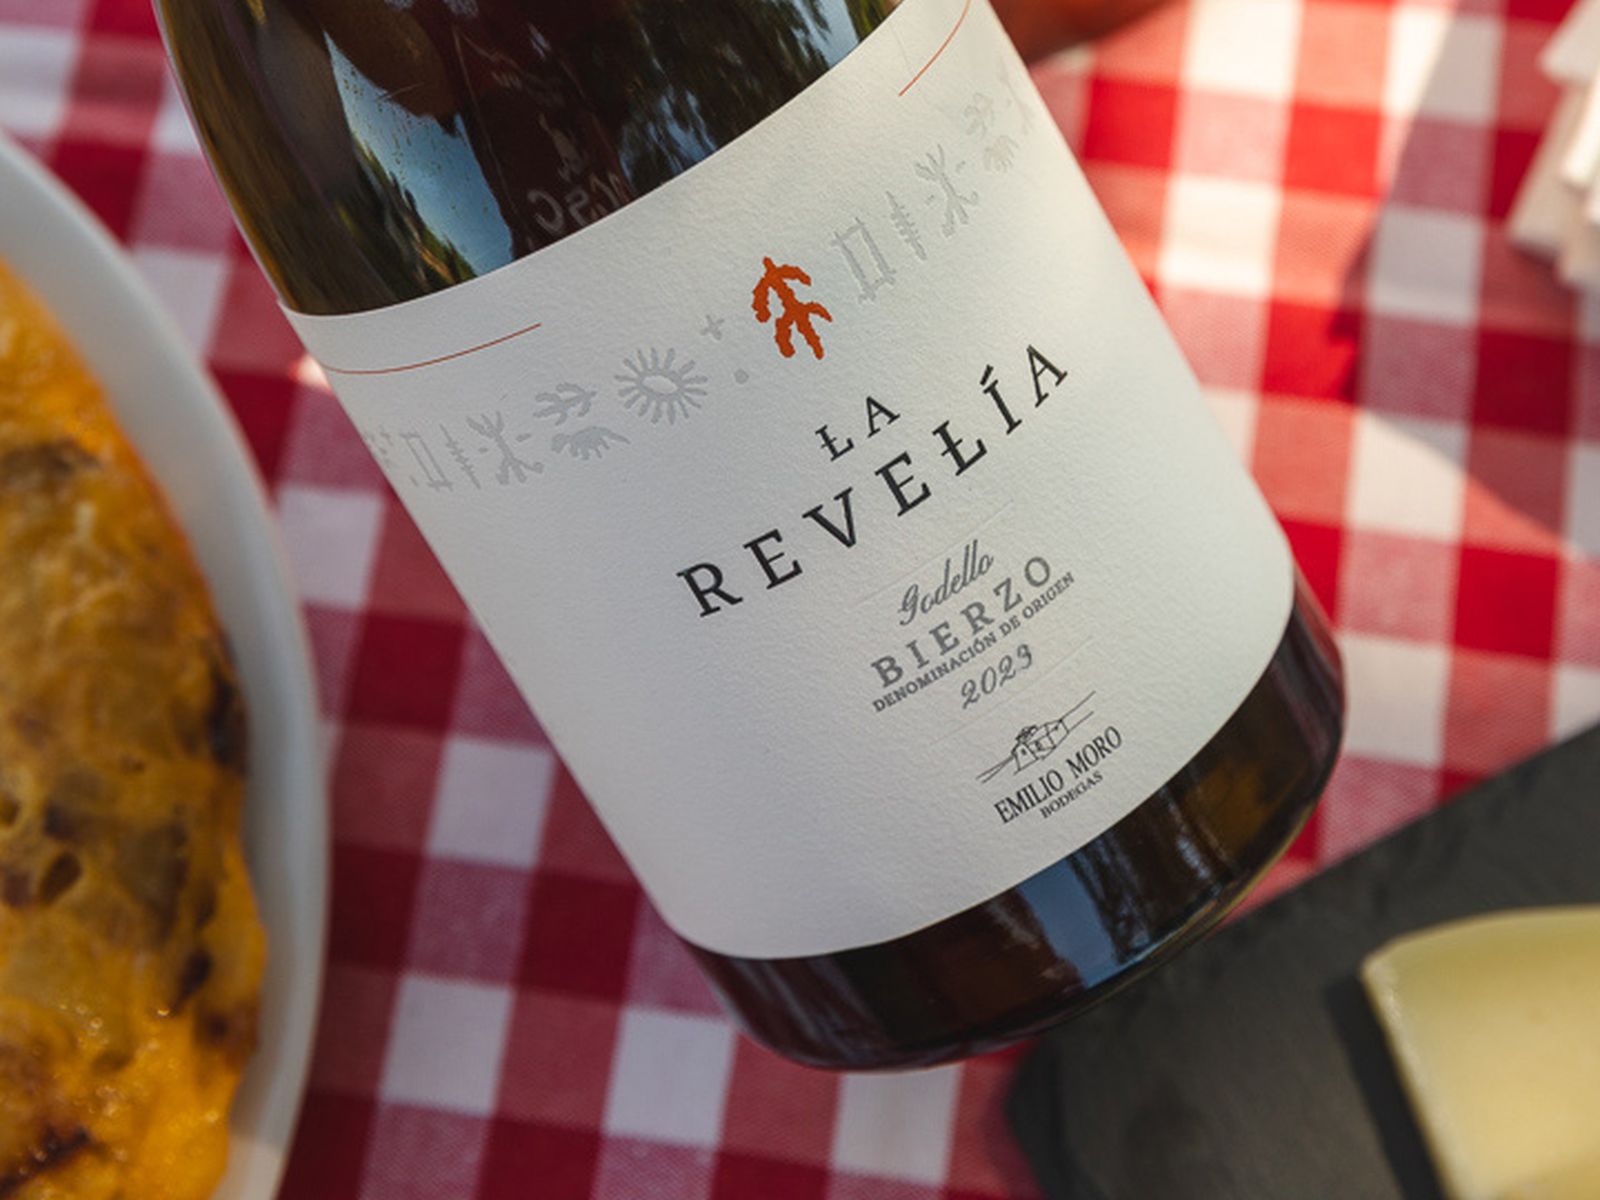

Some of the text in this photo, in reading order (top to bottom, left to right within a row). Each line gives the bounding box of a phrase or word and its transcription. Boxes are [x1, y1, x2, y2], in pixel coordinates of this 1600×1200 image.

[870, 556, 1052, 688] BIERZO
[897, 538, 995, 627] Godello
[871, 571, 1075, 713] DENOMINACIÓN DE ORIGEN
[960, 643, 1034, 710] 2023
[993, 725, 1123, 825] EMILIO MORO
[1039, 771, 1104, 820] BODEGAS
